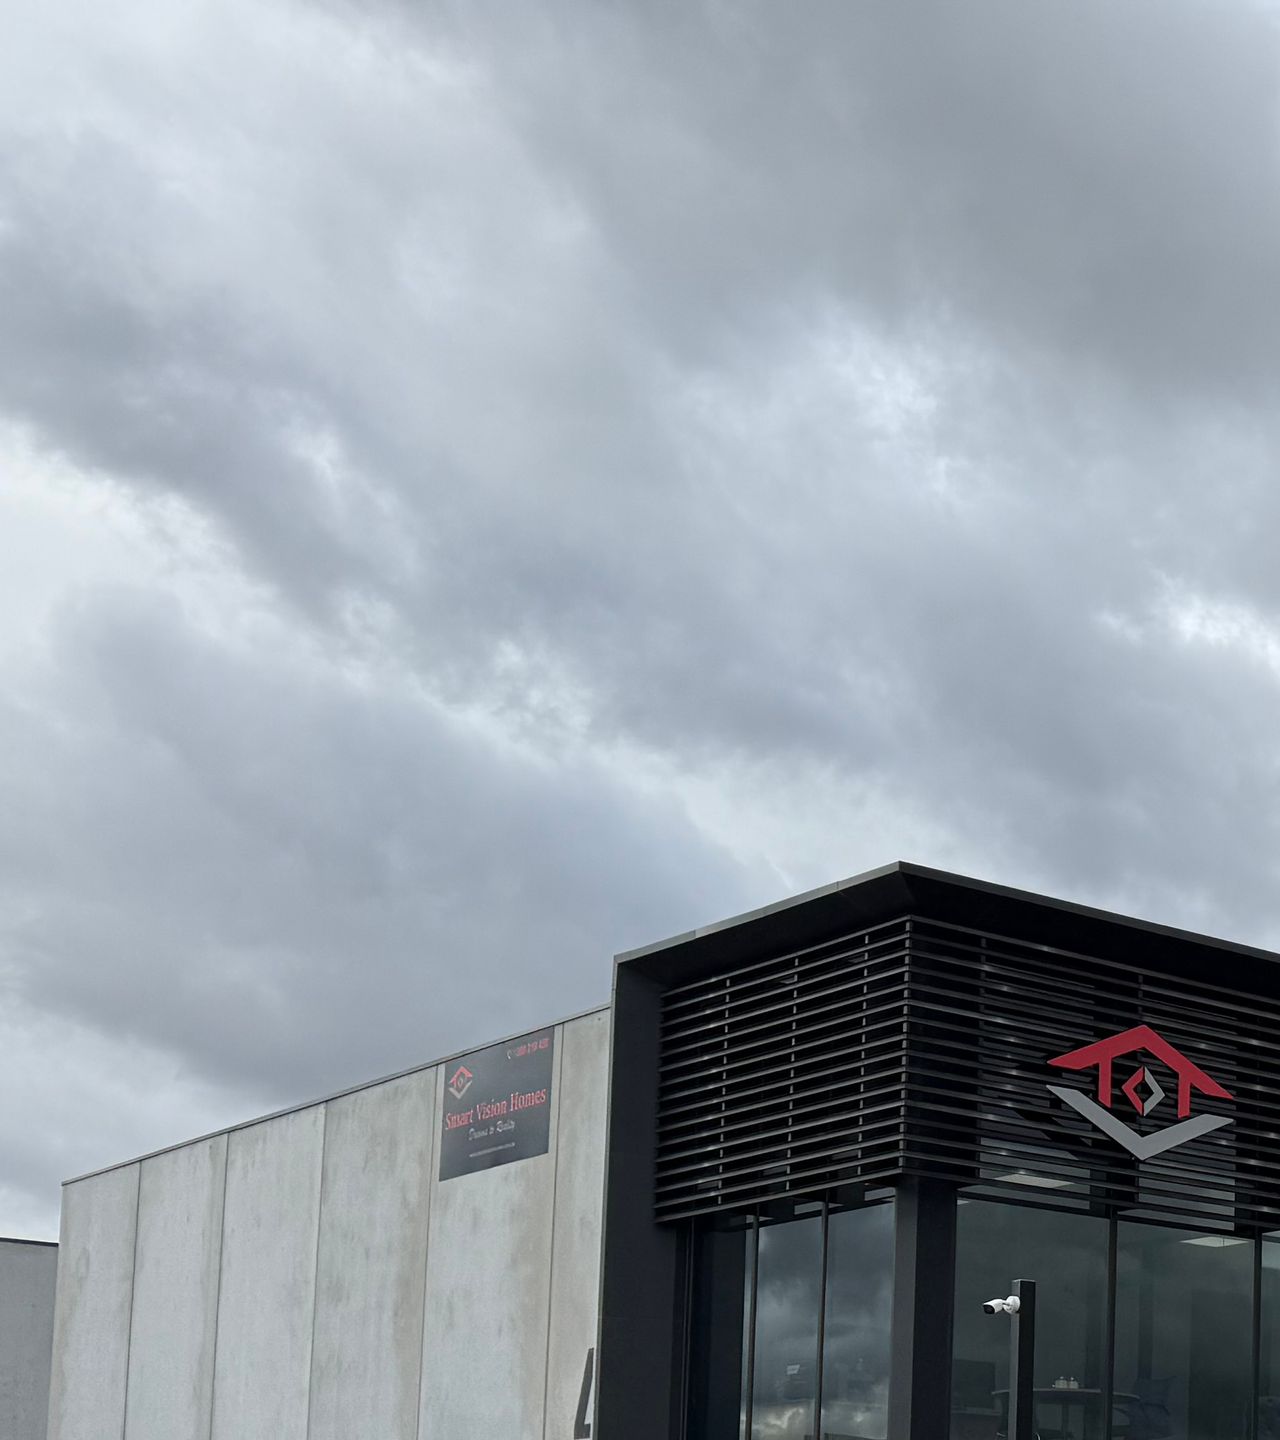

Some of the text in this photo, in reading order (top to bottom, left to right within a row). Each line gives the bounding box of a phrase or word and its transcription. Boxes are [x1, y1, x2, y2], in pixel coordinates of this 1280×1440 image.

[446, 1088, 547, 1131] Smart Vision Homes
